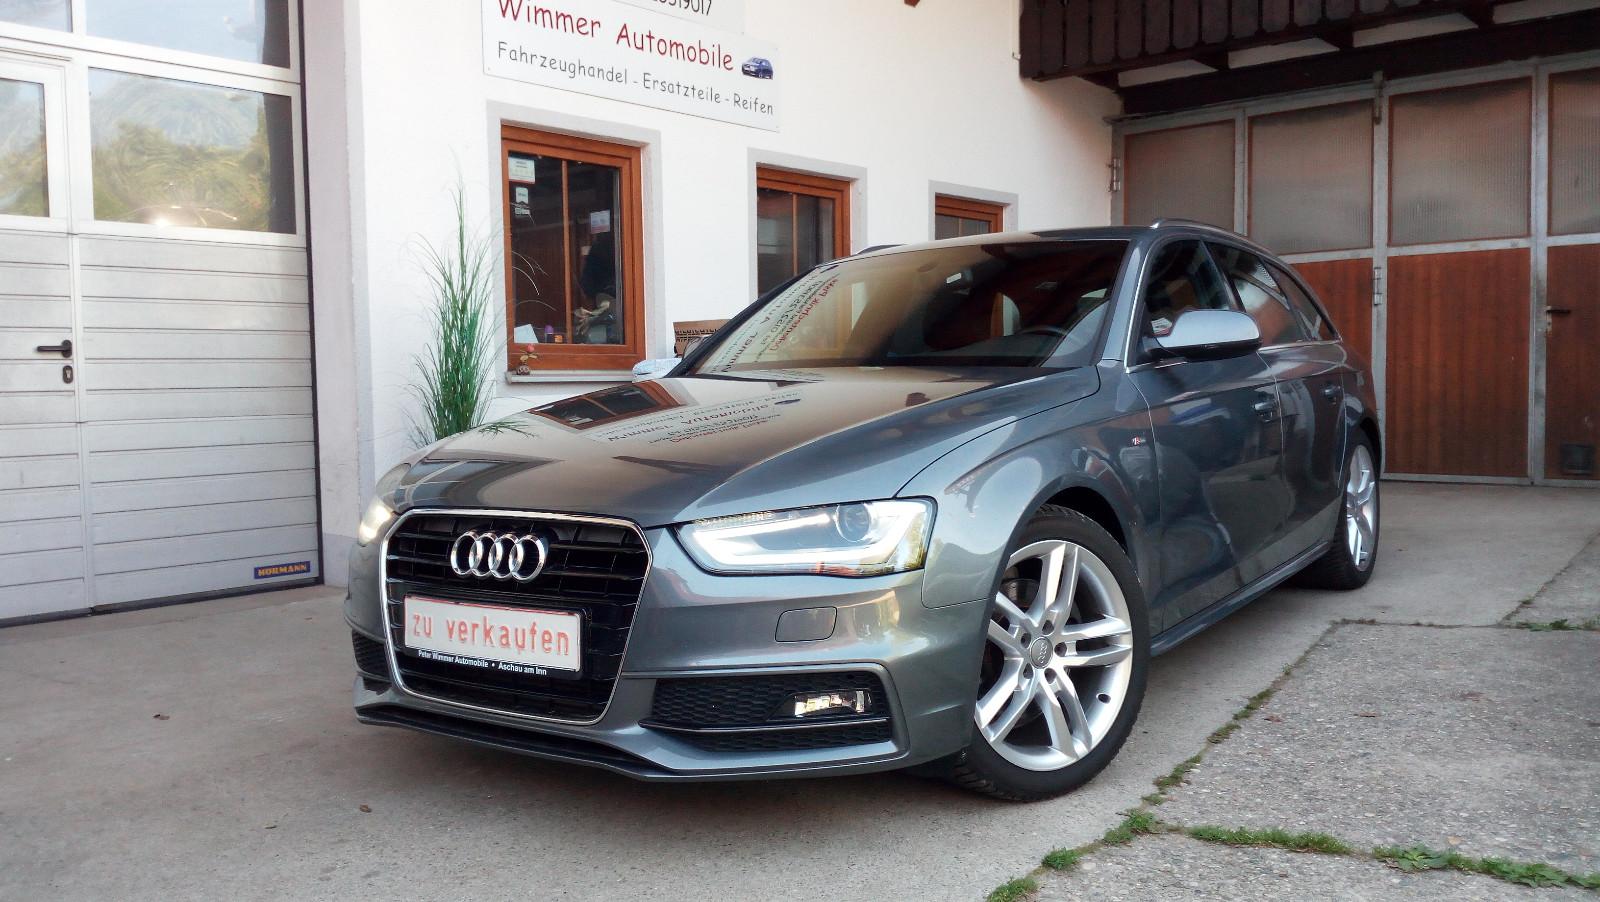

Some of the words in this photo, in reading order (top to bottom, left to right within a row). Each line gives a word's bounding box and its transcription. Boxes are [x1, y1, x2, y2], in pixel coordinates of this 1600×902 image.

[499, 0, 601, 38] Wimmer
[616, 23, 734, 71] Automobile
[497, 41, 627, 85] Fahrzeughandel
[643, 72, 721, 104] Ersatzteile
[733, 93, 773, 115] Reifen
[412, 613, 433, 639] zu
[446, 615, 570, 656] verkaufen
[418, 649, 432, 659] Peter
[432, 651, 454, 664] Wimmer
[455, 655, 489, 669] Automobile
[498, 662, 523, 674] Aschau
[524, 667, 535, 675] am
[535, 666, 547, 676] Inn
